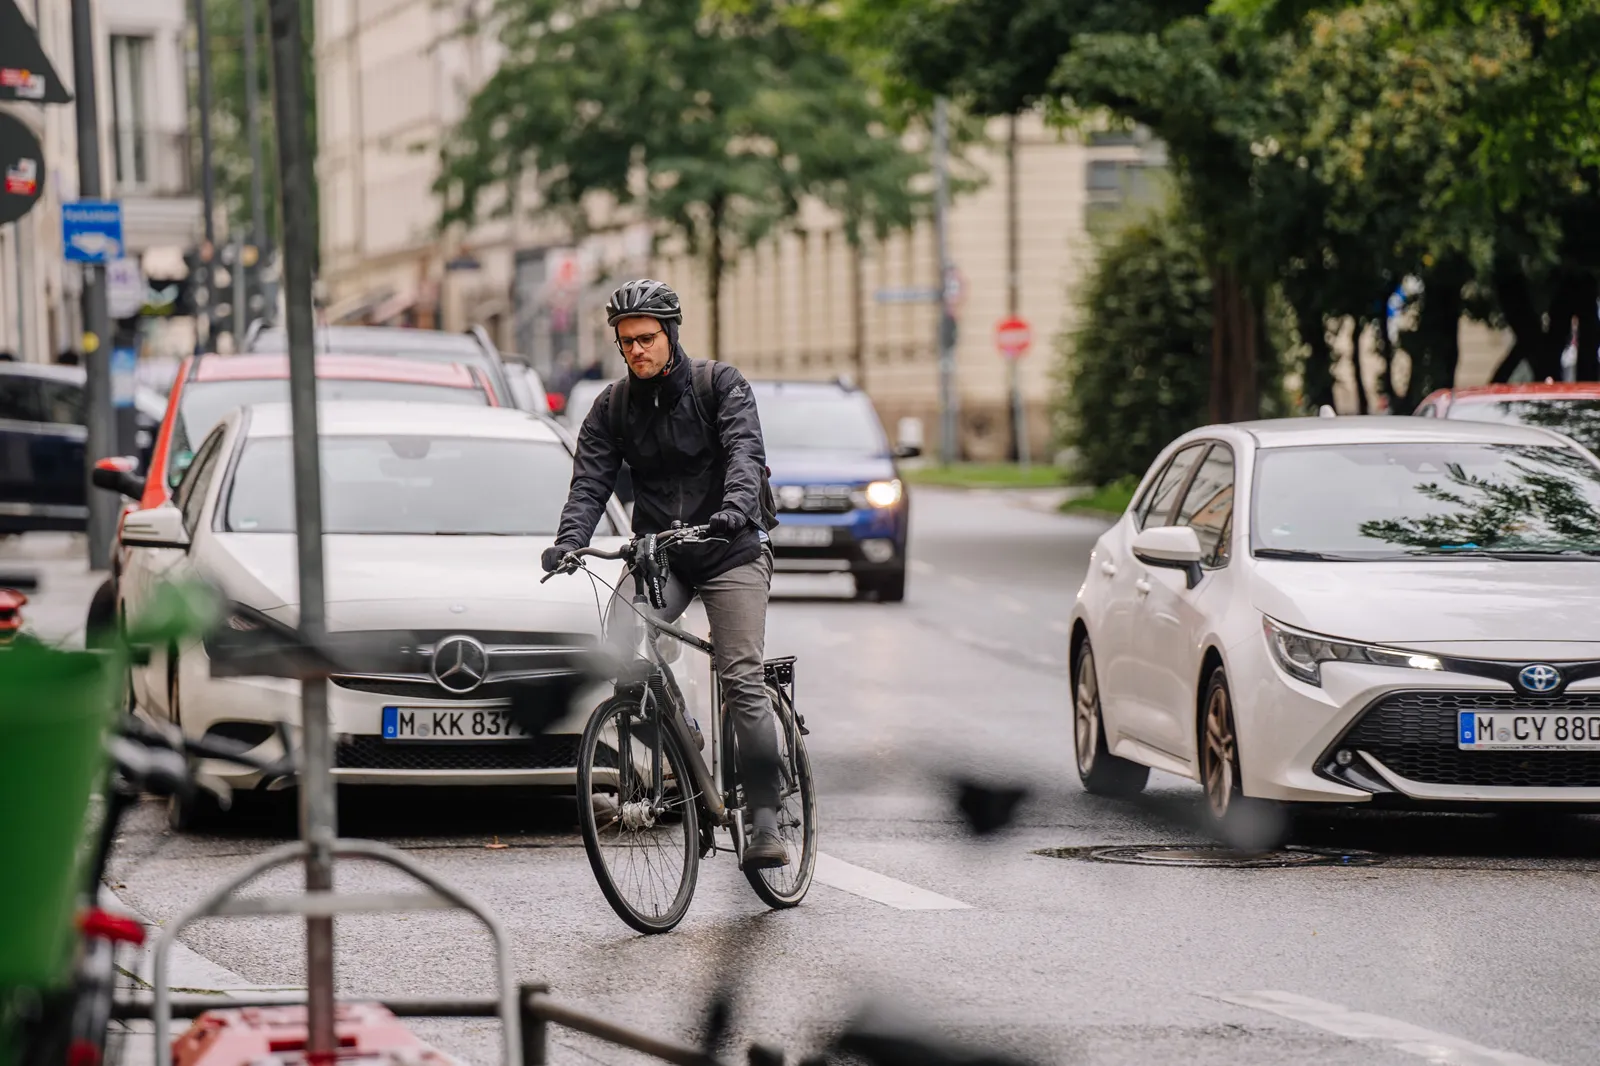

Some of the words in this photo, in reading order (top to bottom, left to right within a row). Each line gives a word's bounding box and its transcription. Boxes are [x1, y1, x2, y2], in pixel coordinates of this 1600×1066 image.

[649, 533, 657, 554] DUNLO
[400, 712, 415, 735] M
[433, 712, 464, 736] KK
[472, 711, 527, 736] 837
[1478, 716, 1494, 741] M
[1514, 716, 1547, 741] CY
